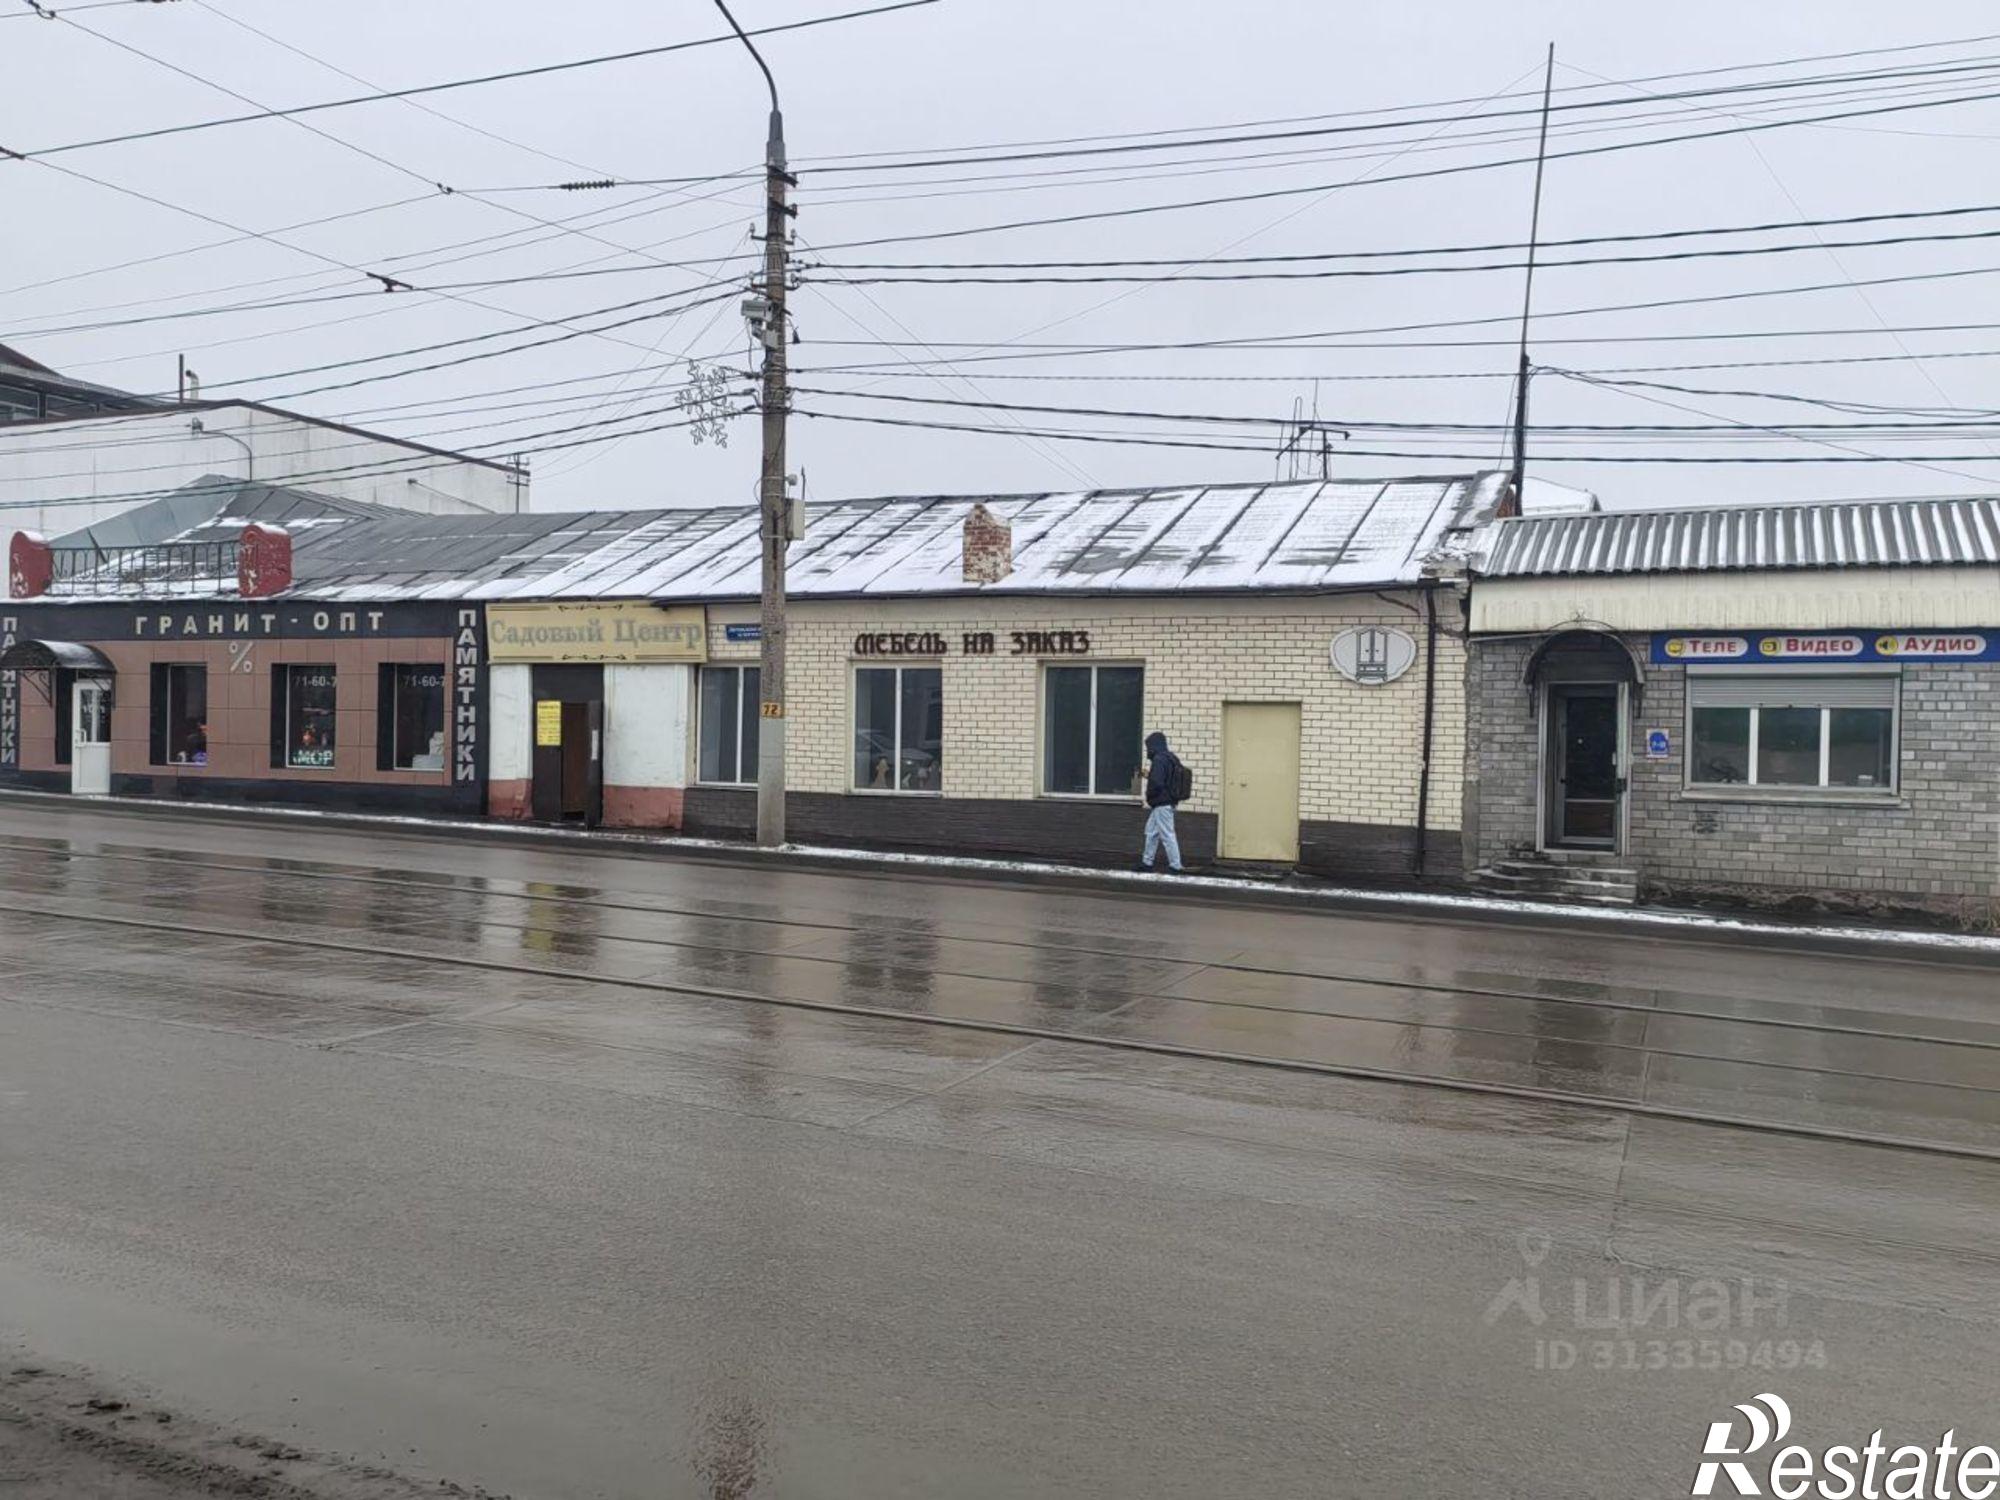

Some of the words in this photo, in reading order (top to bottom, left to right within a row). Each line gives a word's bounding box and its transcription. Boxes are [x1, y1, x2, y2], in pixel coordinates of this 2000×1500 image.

[490, 619, 604, 647] Садовый
[614, 618, 701, 649] Центр
[854, 632, 948, 655] МЕБЕЛЬ
[963, 632, 995, 654] НА
[1010, 631, 1090, 655] ЗАКАЗ
[1, 617, 18, 763] ПАЯТНИКИ
[456, 610, 477, 781] ПАМЯТНИКИ
[763, 704, 778, 715] 72
